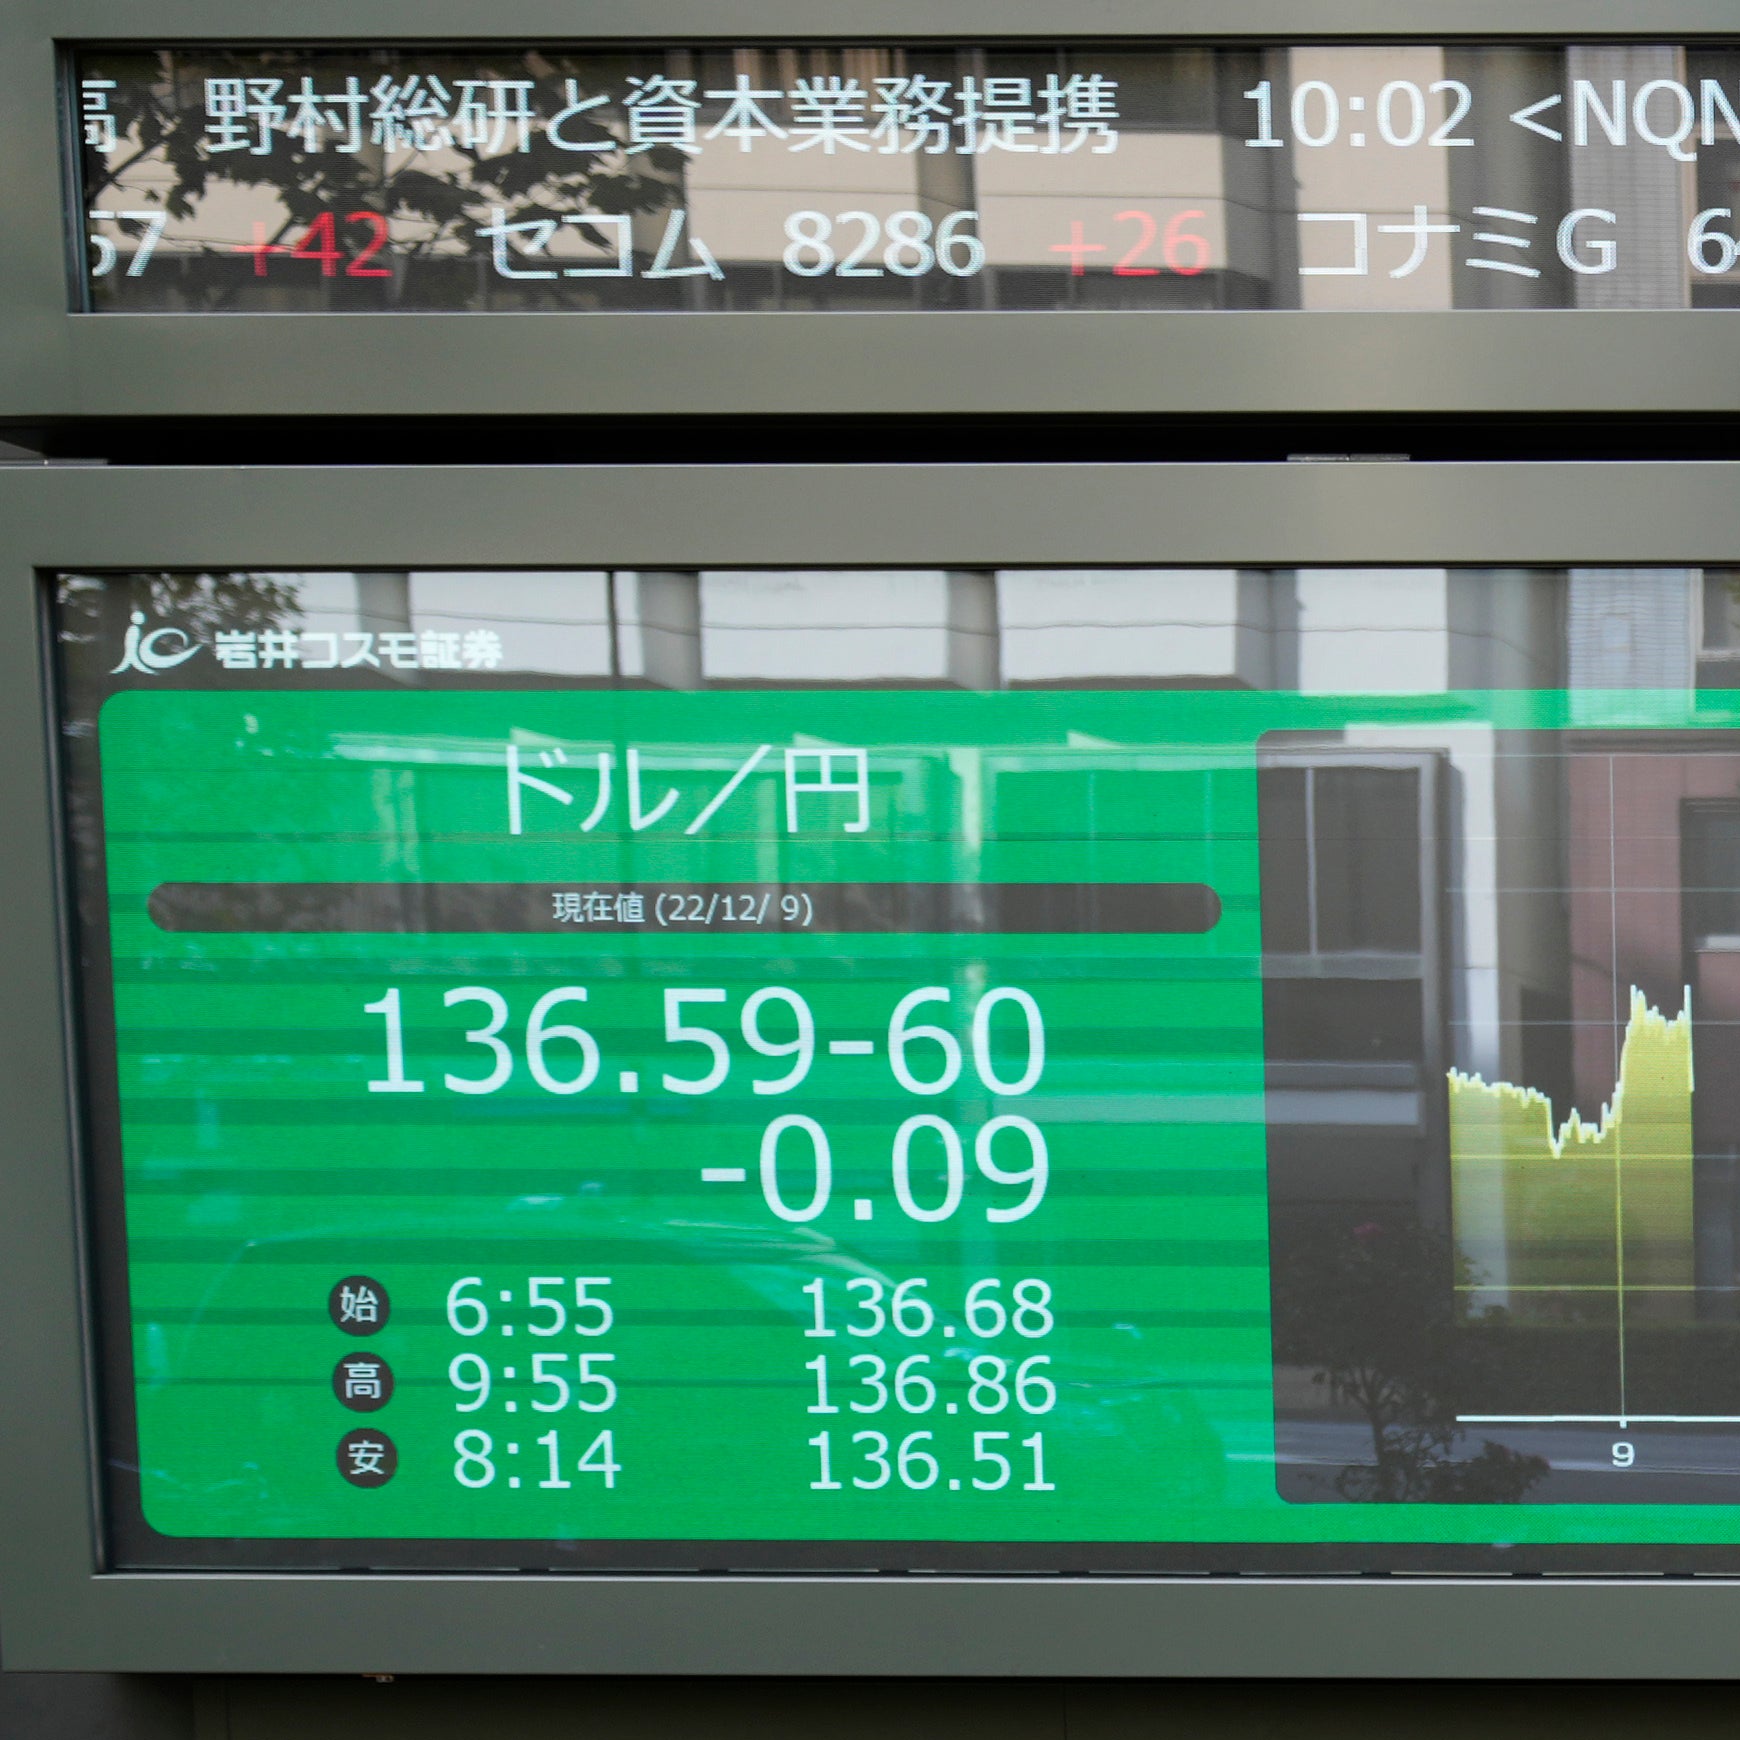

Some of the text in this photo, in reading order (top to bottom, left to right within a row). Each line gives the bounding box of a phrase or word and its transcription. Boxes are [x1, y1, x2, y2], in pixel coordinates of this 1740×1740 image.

[204, 74, 1119, 156] 野村総研と資本業務提携
[1243, 79, 1476, 148] 10:02
[233, 210, 394, 278] +42
[474, 207, 725, 281] セコム
[782, 210, 987, 278] 8286
[1047, 209, 1212, 277] +26
[1297, 204, 1618, 279] コナミG
[214, 629, 504, 670] 岩井コスモ証券
[551, 892, 645, 925] 現在値
[364, 986, 1046, 1096] 136.59-60
[701, 1114, 1049, 1223] -0.09
[340, 1276, 1055, 1339] 始 6:55 136.68
[343, 1353, 1057, 1415] 高 9:55 136.86
[347, 1429, 1056, 1491] 安 8:14 136.51
[1611, 1441, 1636, 1468] 9
